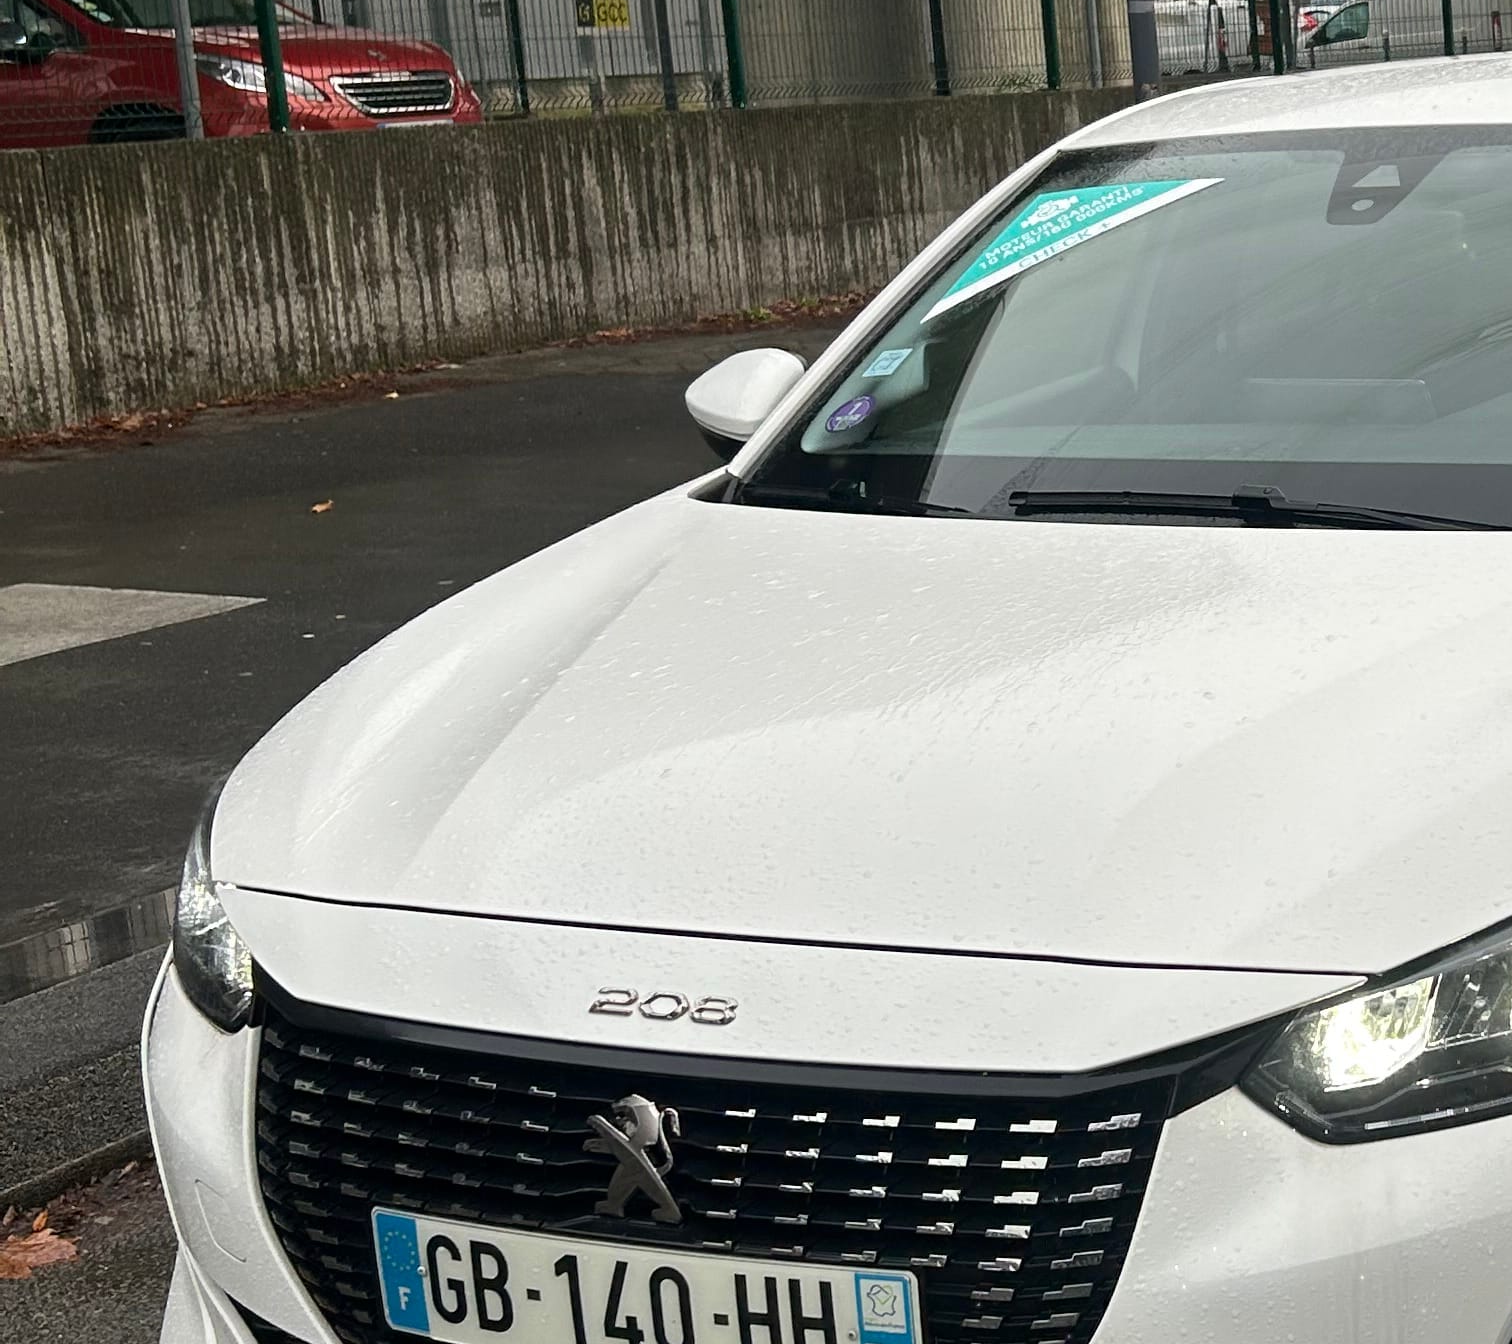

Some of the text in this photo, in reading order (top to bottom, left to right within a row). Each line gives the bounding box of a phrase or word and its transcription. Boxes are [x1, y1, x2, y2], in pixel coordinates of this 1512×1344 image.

[984, 186, 1129, 260] MOTEUR GARANTI
[978, 256, 999, 270] 10
[1019, 229, 1093, 269] CHECK
[589, 987, 739, 1026] 208
[398, 1286, 411, 1311] F
